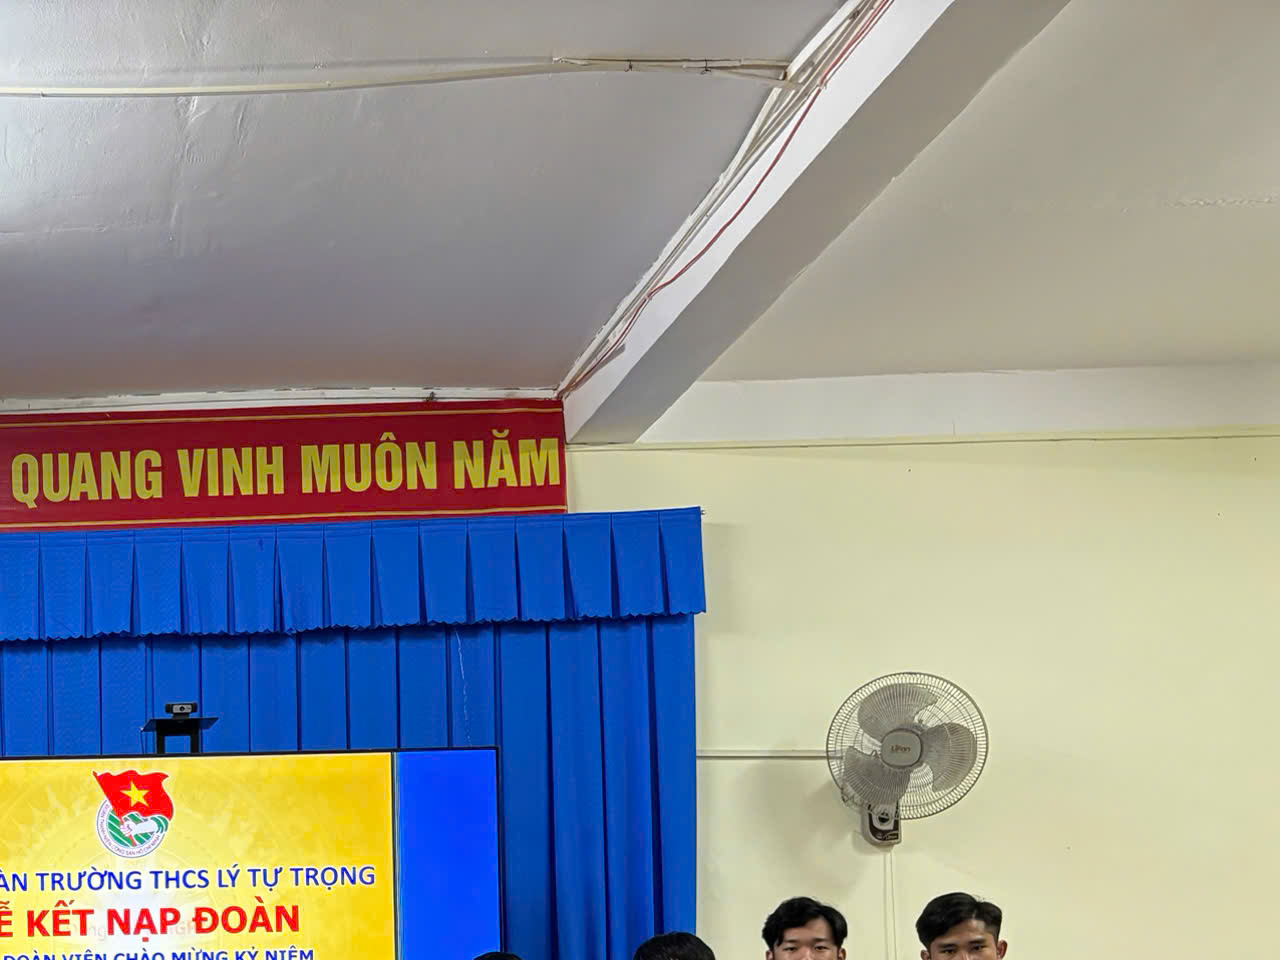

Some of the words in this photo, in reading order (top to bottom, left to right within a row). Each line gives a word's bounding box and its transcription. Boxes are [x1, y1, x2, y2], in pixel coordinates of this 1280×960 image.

[11, 448, 163, 508] QUANG
[177, 445, 284, 498] VINH
[301, 431, 438, 494] MUÔN
[453, 428, 561, 489] NĂM
[35, 866, 142, 891] TRƯỜNG
[149, 869, 210, 889] THCS
[218, 864, 240, 887] LÝ
[247, 867, 282, 892] TỰ
[290, 866, 376, 890] TRỌNG
[27, 899, 94, 937] KẾT
[107, 907, 181, 942] NẠP
[192, 896, 299, 934] ĐOÀN
